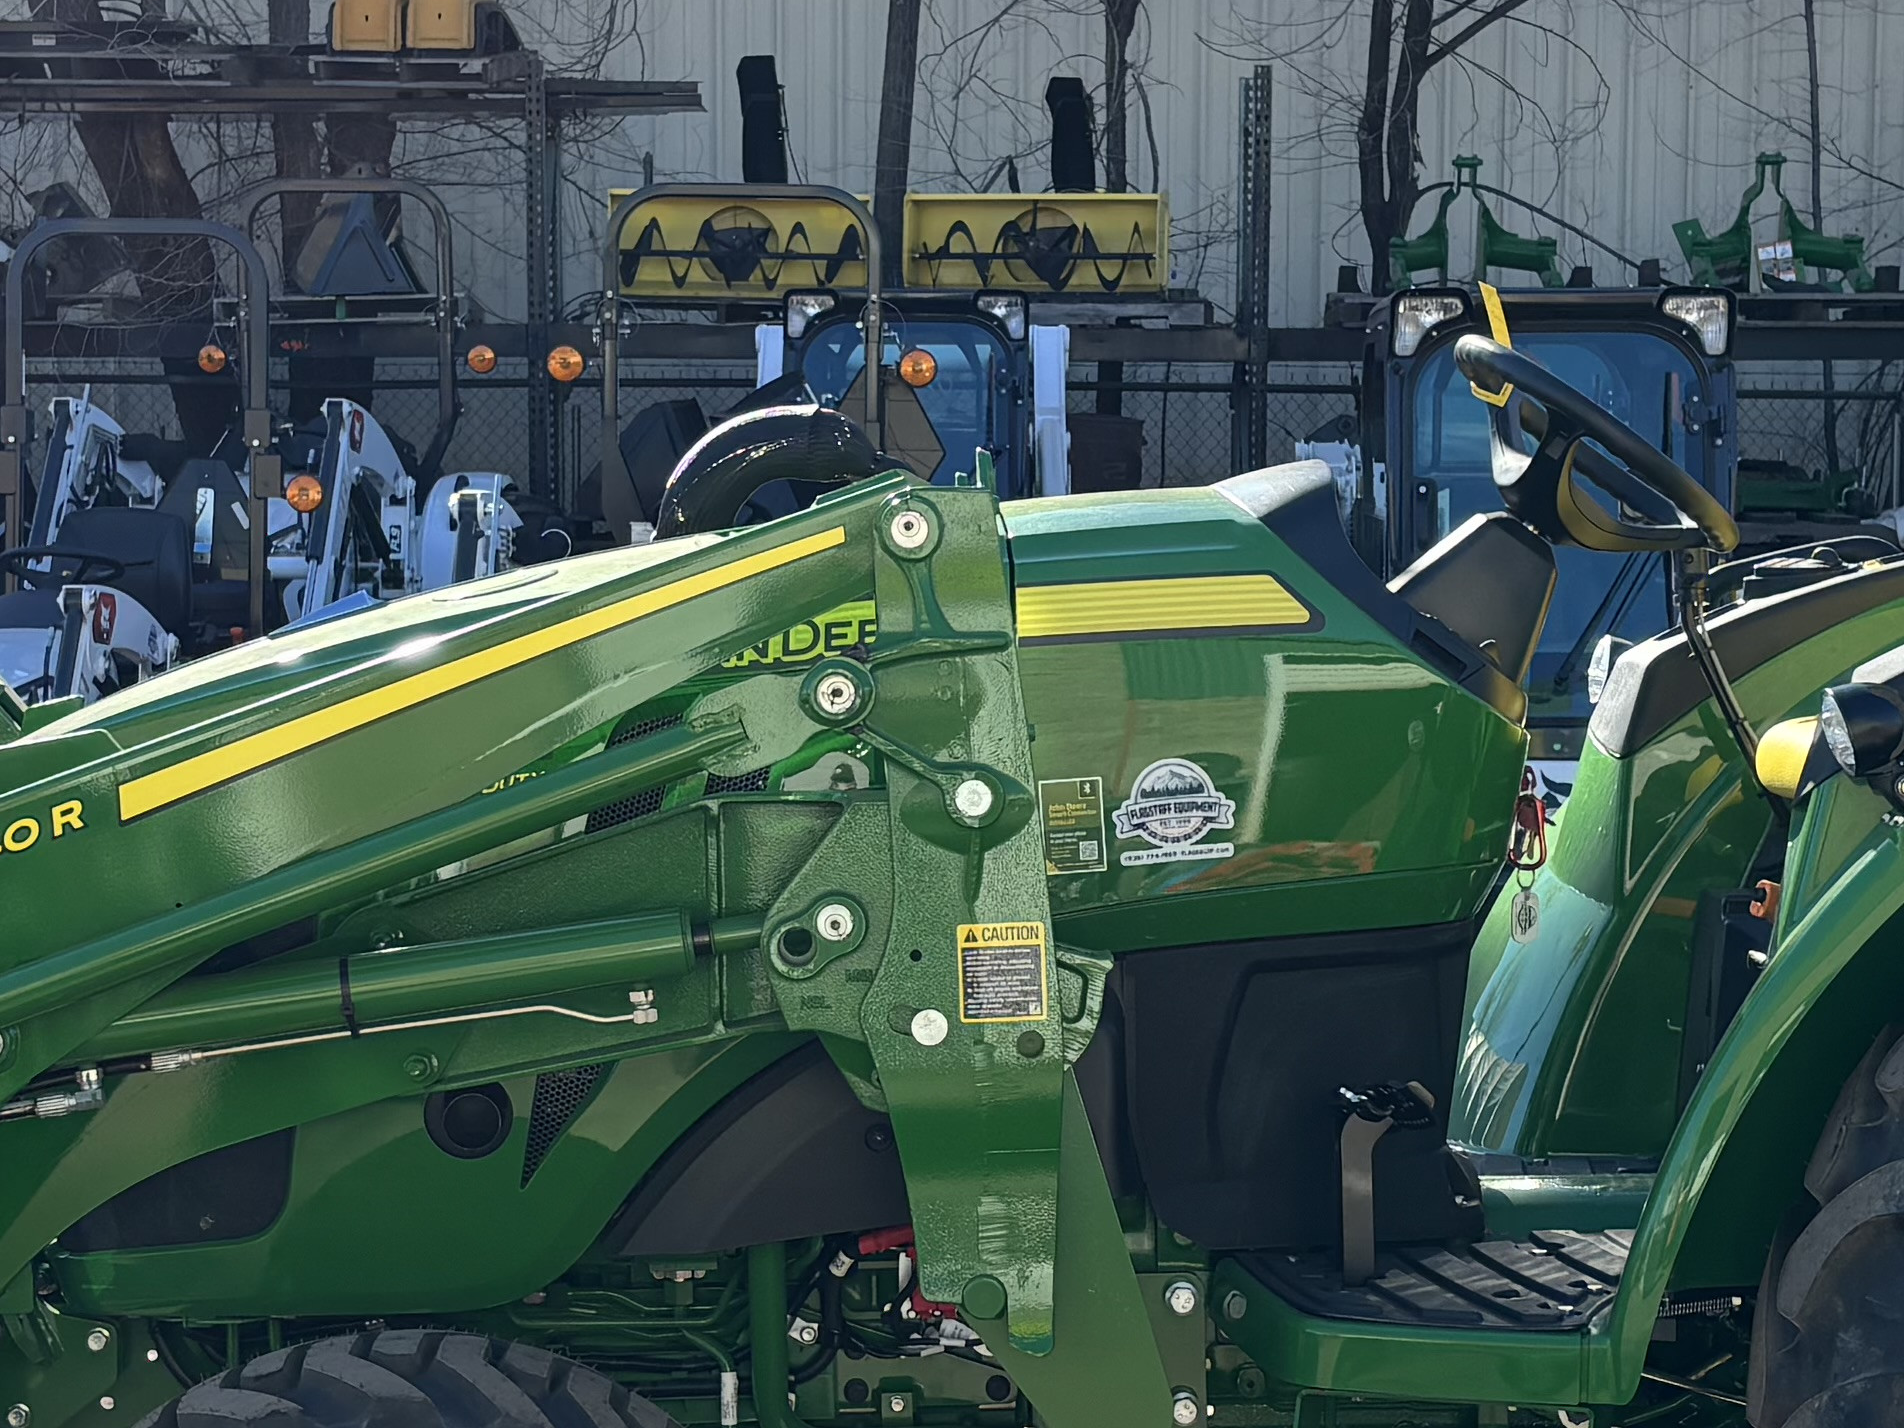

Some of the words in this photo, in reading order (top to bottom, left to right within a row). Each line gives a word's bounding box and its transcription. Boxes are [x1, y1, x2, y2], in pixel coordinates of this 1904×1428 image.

[51, 799, 85, 838] R
[1130, 803, 1172, 820] FLAGSTAFF
[1173, 801, 1219, 814] EQUIPMENT
[982, 925, 1040, 942] CAUTION
